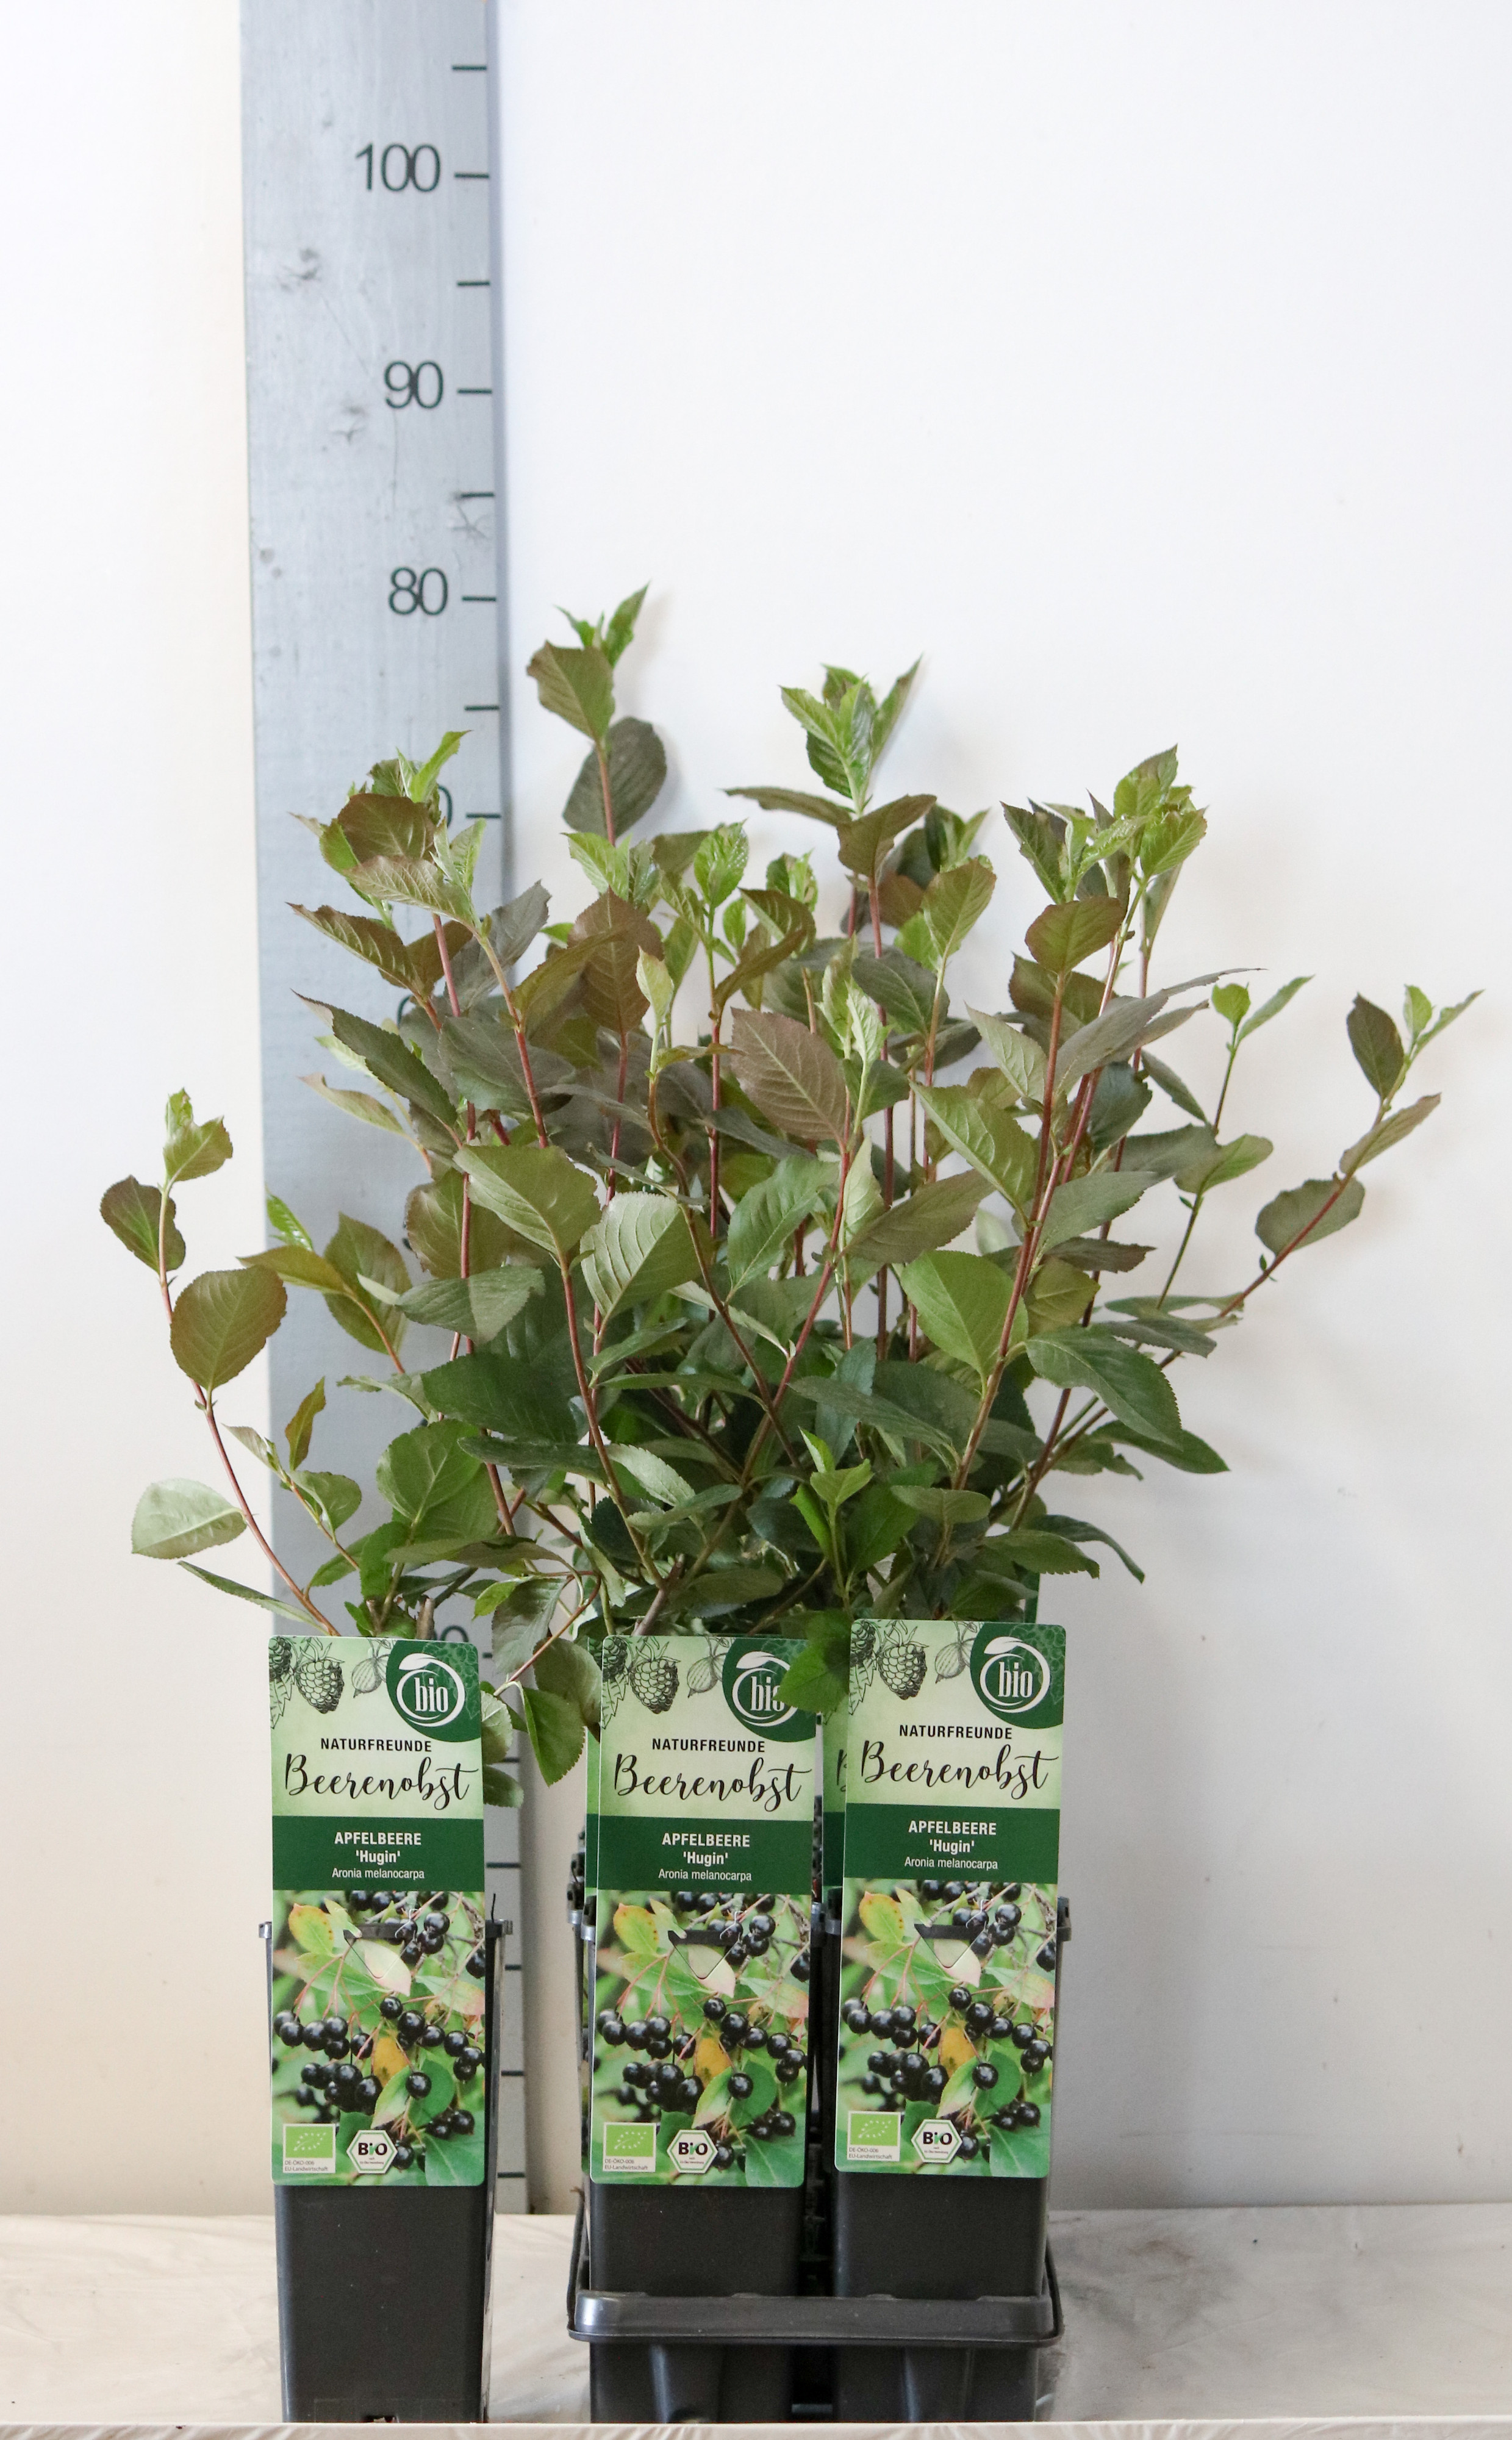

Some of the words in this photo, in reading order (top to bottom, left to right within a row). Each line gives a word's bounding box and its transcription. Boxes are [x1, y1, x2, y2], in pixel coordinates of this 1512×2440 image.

[354, 142, 442, 193] 100
[383, 360, 444, 410] 90
[389, 567, 448, 615] 80
[998, 1662, 1033, 1698] bio
[415, 1677, 449, 1713] bio
[899, 1724, 1013, 1740] NATURFREUNDE
[320, 1738, 432, 1753] NATURFREUNDE
[652, 1738, 765, 1753] NATURFREUNDE
[861, 1740, 1059, 1800] Beerenobst
[285, 1753, 480, 1810] Beerenobst
[614, 1753, 812, 1812] Beerenobst
[908, 1820, 997, 1835] APFELBEERE
[334, 1832, 422, 1845] APFELBEERE
[662, 1832, 751, 1847] APFELBEERE
[930, 1839, 975, 1854] 'Hugin'
[356, 1850, 401, 1864] 'Hugin'
[683, 1851, 729, 1866] 'Hugin'
[904, 1856, 935, 1868] Aronia
[937, 1857, 998, 1870] melanocarpa
[332, 1868, 362, 1879] Aronia
[365, 1869, 425, 1880] melanocarpa
[658, 1868, 689, 1879] Aronia
[691, 1870, 752, 1882] melanocarpa
